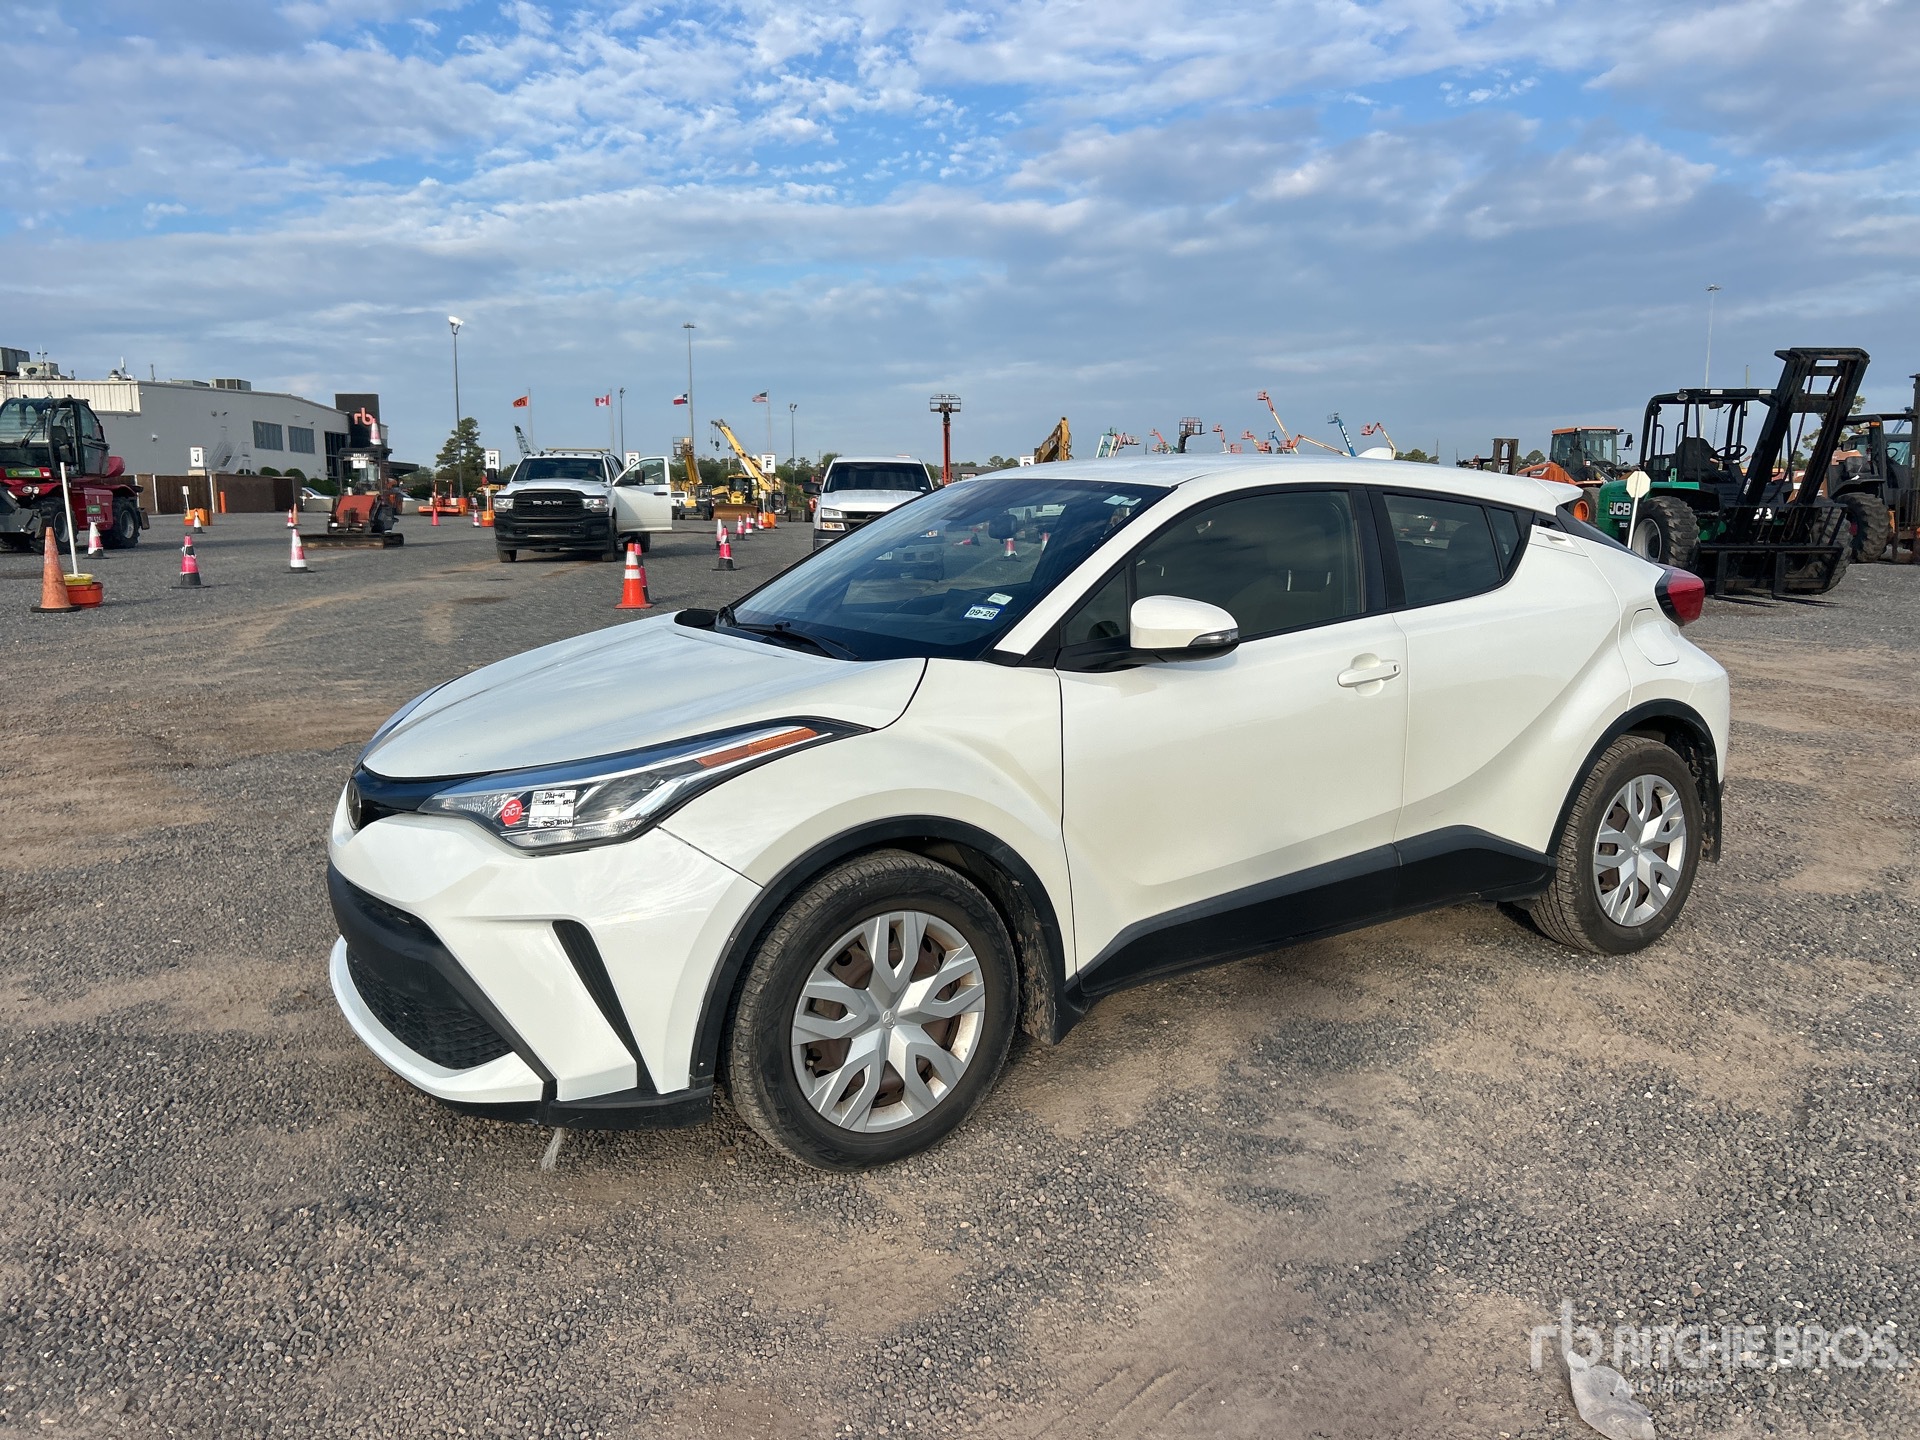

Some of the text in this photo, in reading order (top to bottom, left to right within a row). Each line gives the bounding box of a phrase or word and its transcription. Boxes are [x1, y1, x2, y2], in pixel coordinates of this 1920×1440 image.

[354, 407, 375, 425] rb
[194, 453, 200, 463] J
[489, 456, 496, 465] H
[765, 459, 772, 469] F
[1609, 502, 1631, 516] JCB
[504, 807, 521, 817] OCT
